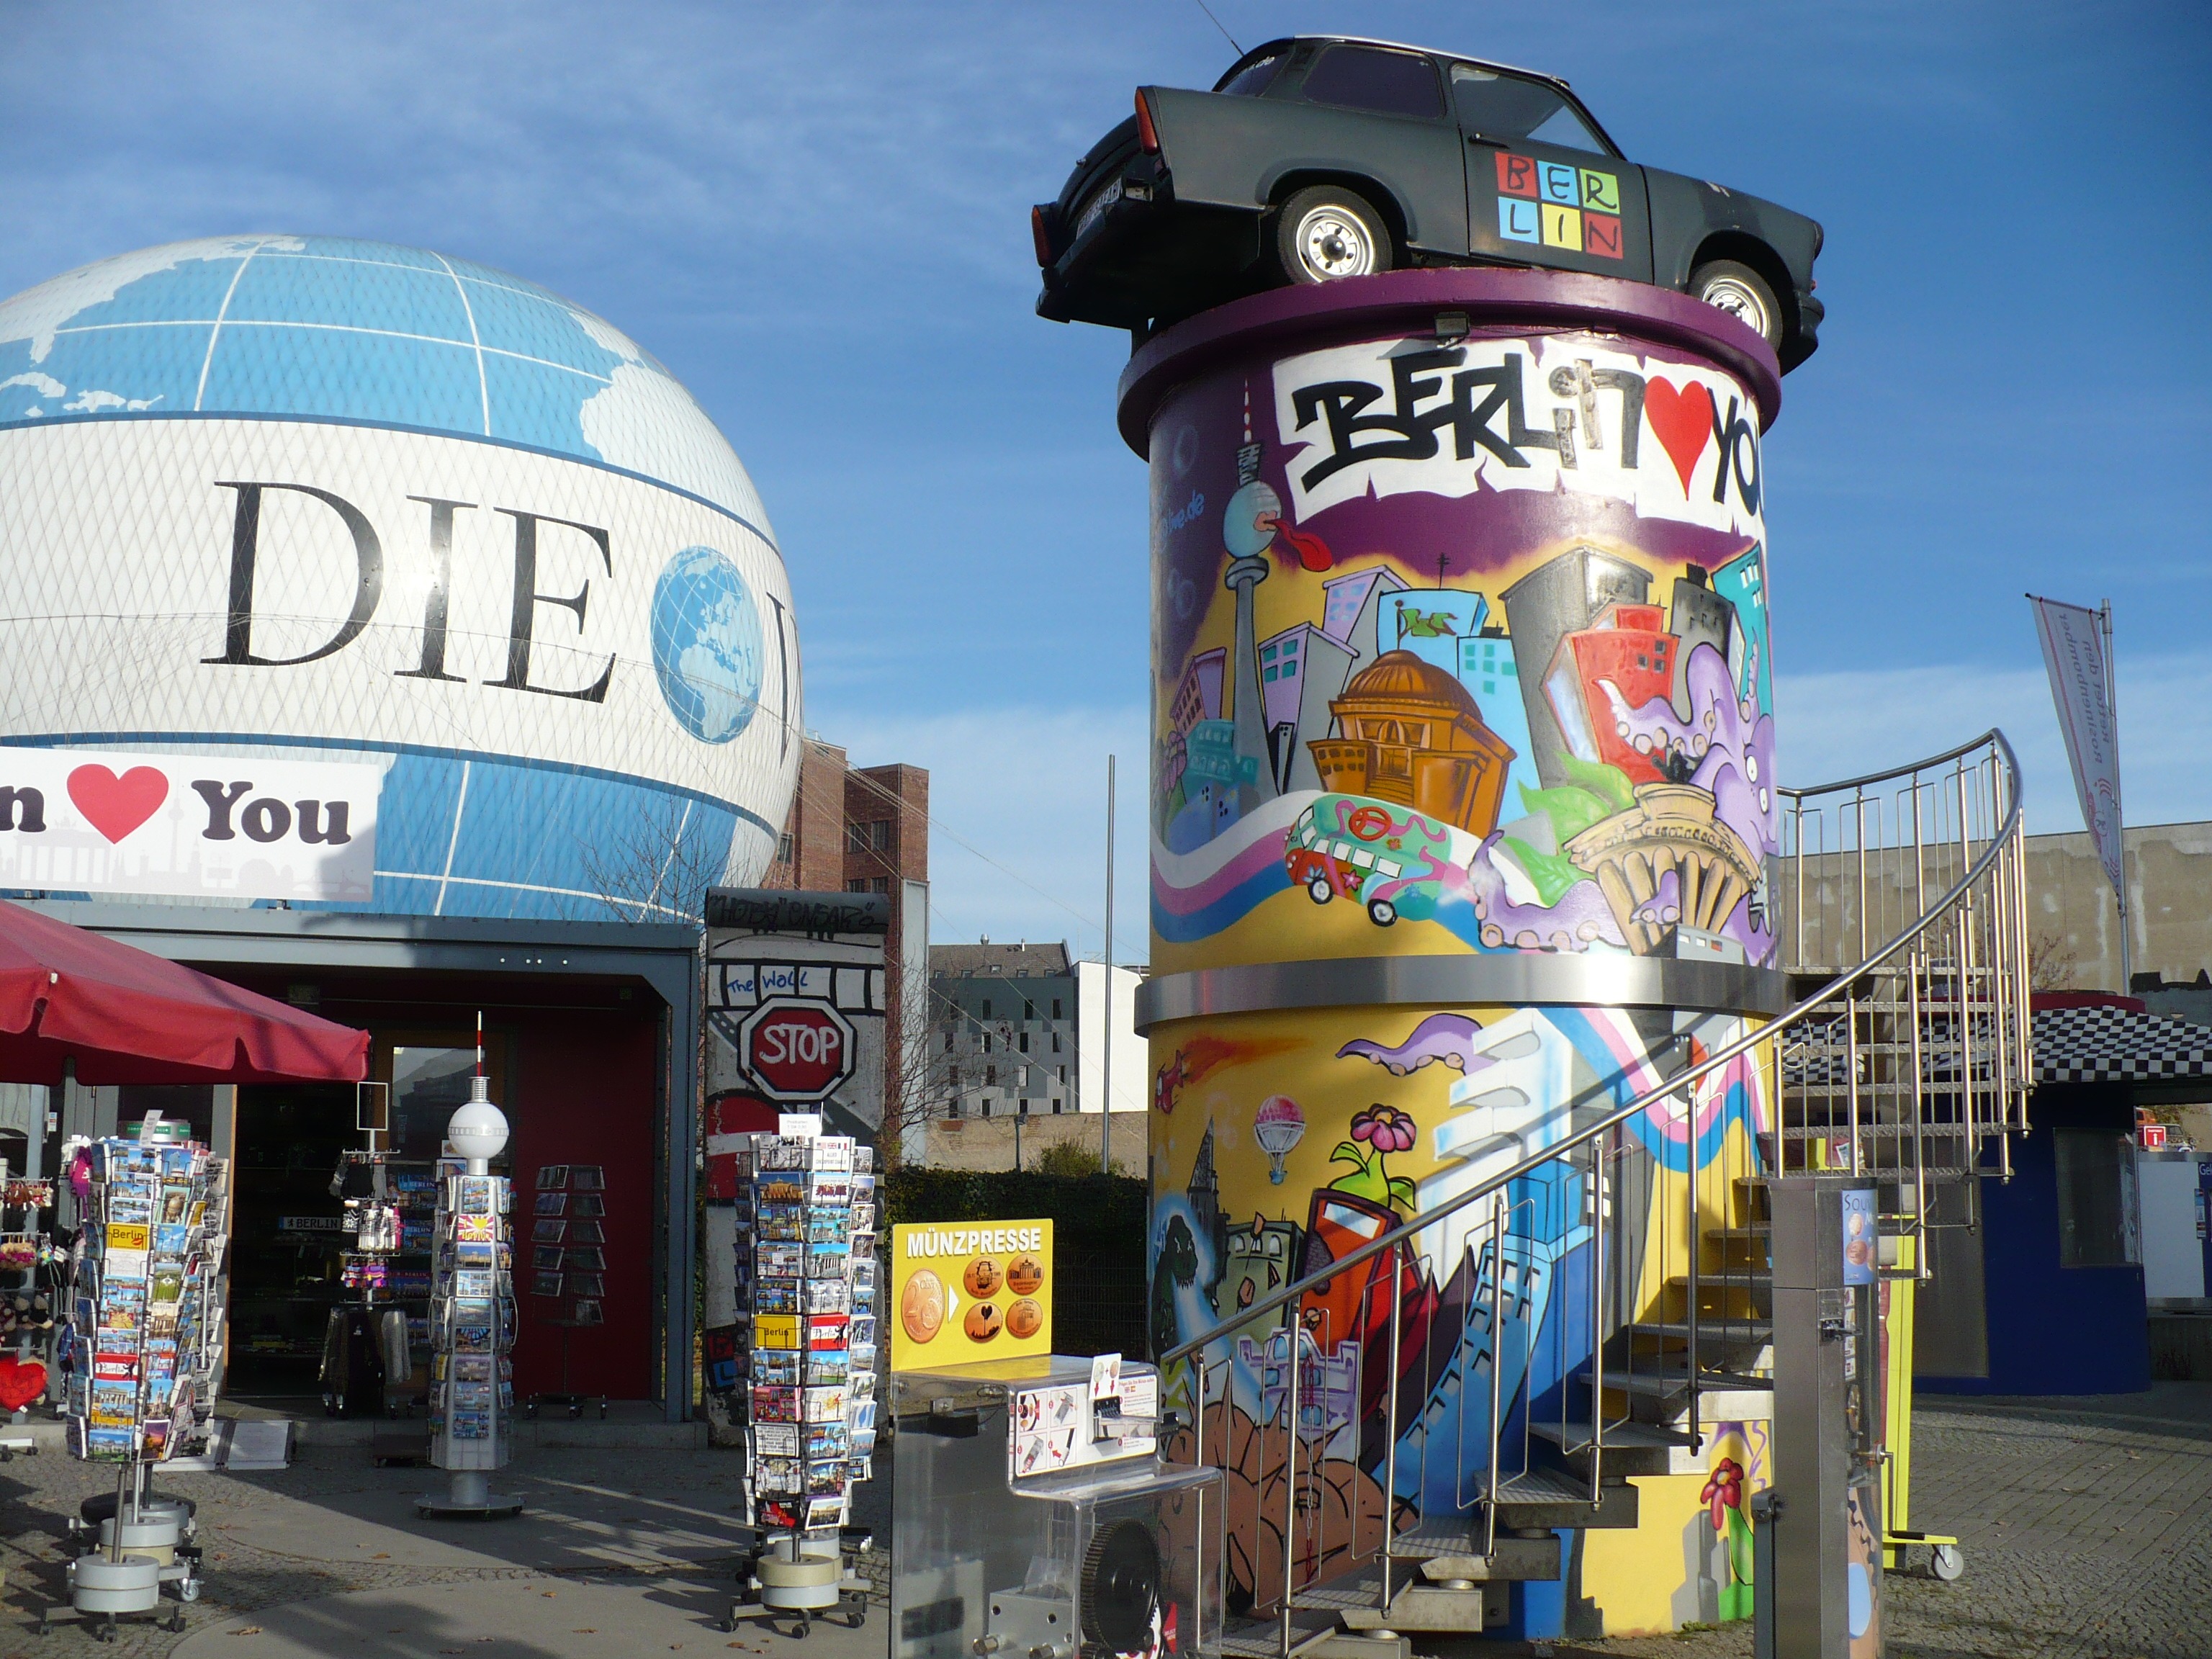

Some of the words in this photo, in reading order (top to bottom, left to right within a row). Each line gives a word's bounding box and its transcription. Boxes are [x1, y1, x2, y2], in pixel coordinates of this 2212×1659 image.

[1509, 203, 1619, 252] LIN
[199, 480, 618, 704] DIE
[190, 779, 352, 845] You
[759, 1022, 840, 1065] STOP
[112, 1228, 144, 1240] Berlin
[296, 1218, 338, 1228] BERLIN
[907, 1228, 1041, 1257] MÜNZPRESSE
[764, 1327, 789, 1336] Berlin
